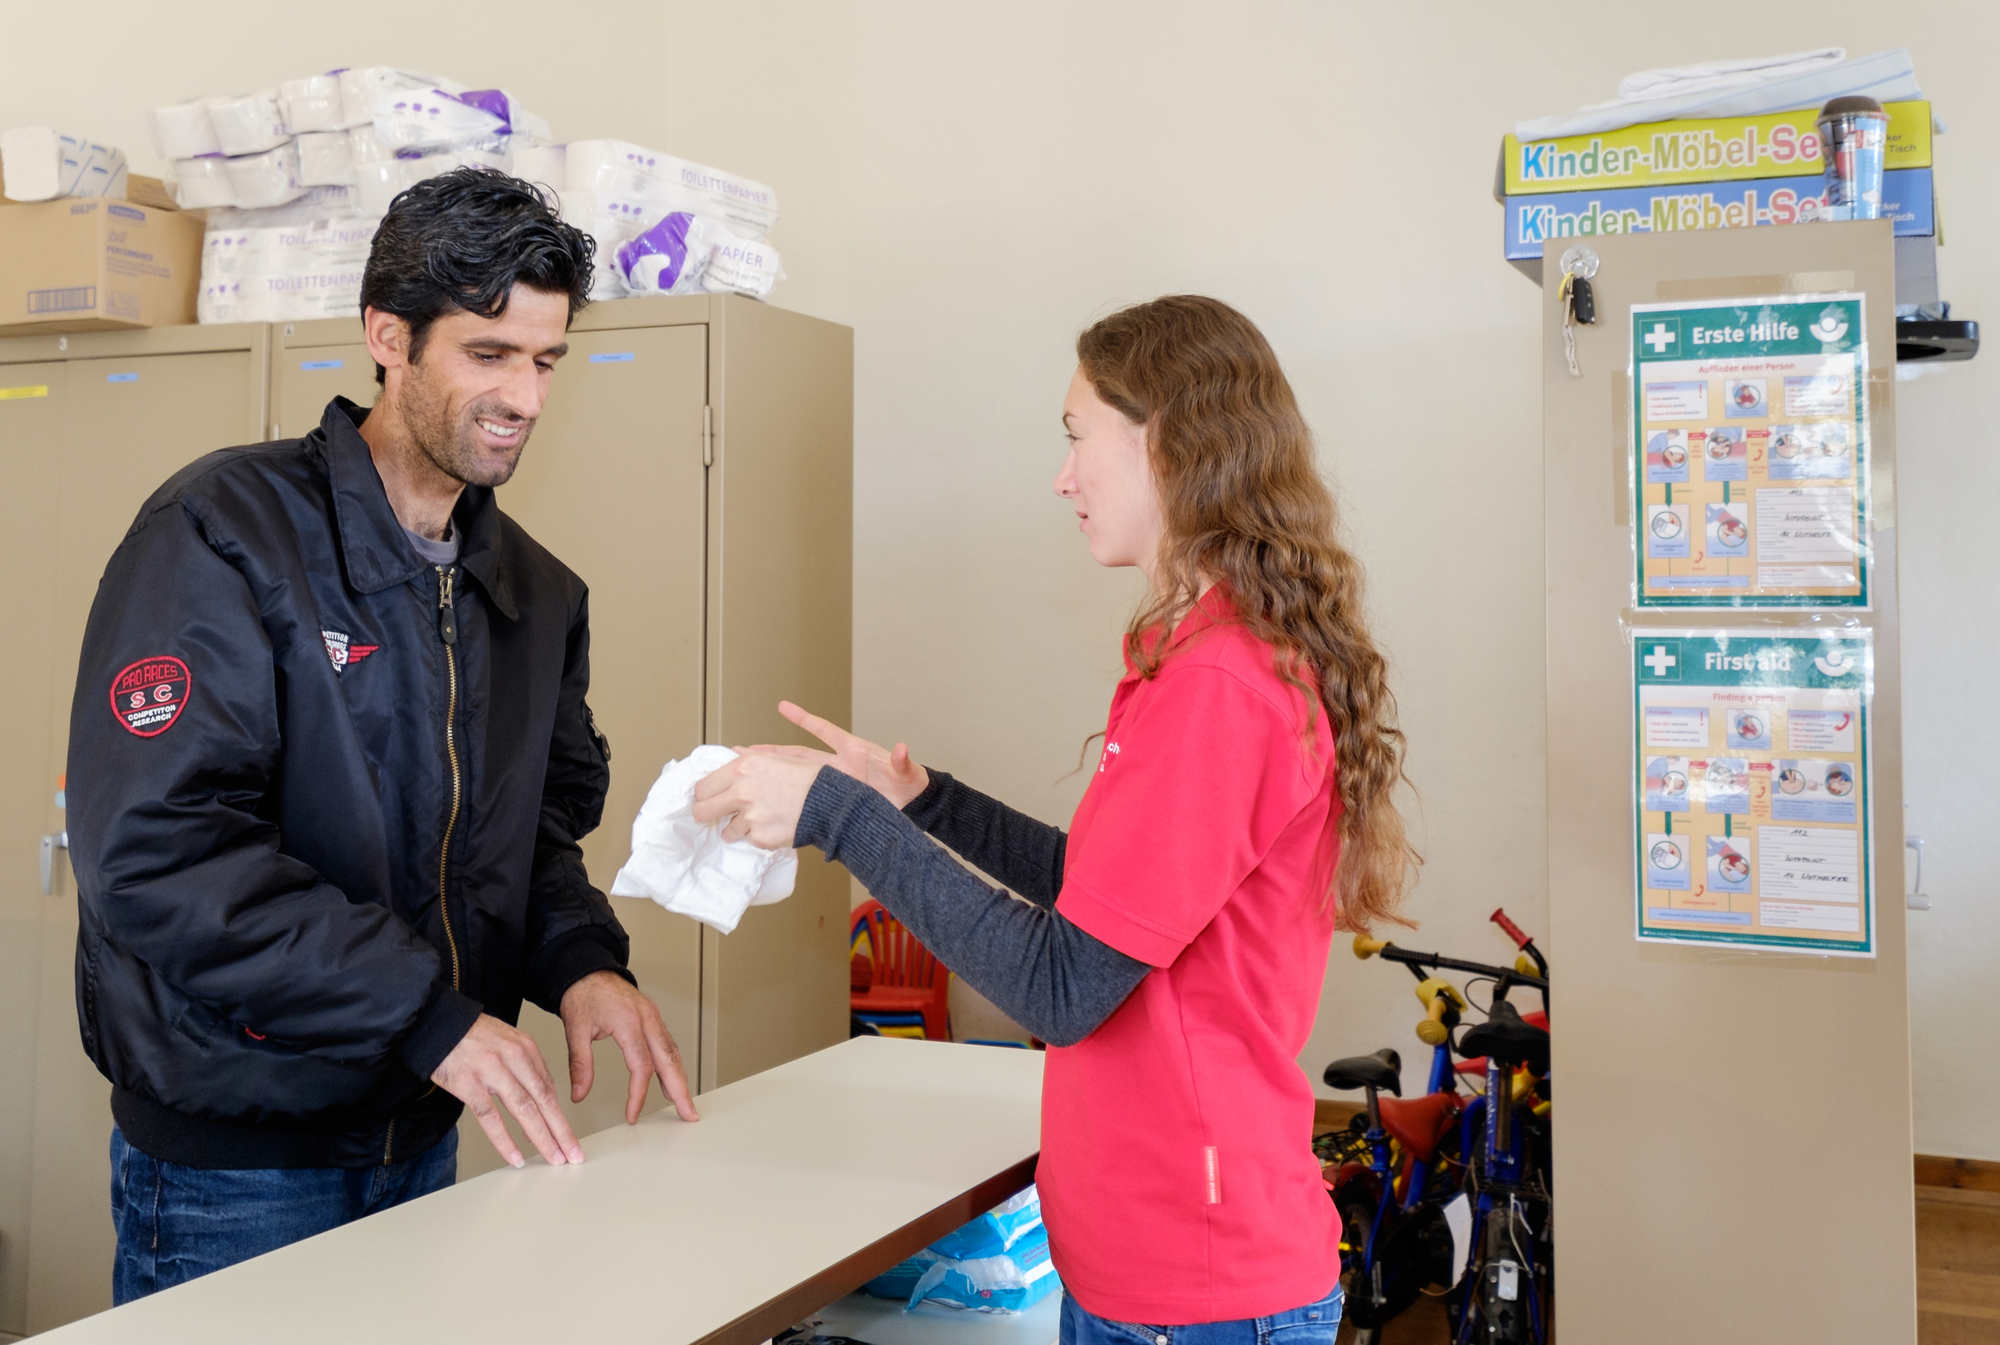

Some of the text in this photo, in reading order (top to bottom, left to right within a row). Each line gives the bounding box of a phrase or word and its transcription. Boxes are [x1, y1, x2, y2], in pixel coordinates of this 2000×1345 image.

[1886, 134, 1902, 142] ker
[1520, 125, 1823, 182] Kinder-Möbel-Se
[1889, 144, 1917, 153] Tisch
[681, 168, 769, 204] TOILETTENPAPIER
[1517, 188, 1830, 244] Kinder-Möbel-Se
[267, 271, 363, 292] TOILETTENPAP
[1692, 322, 1800, 344] Erste Hilfe
[1698, 362, 1795, 374] Auffinden einer Person
[1704, 651, 1791, 671] First aid
[130, 684, 173, 709] S C
[1713, 692, 1786, 703] Finding a person
[131, 713, 172, 728] RESEARCH
[1107, 743, 1121, 754] ch
